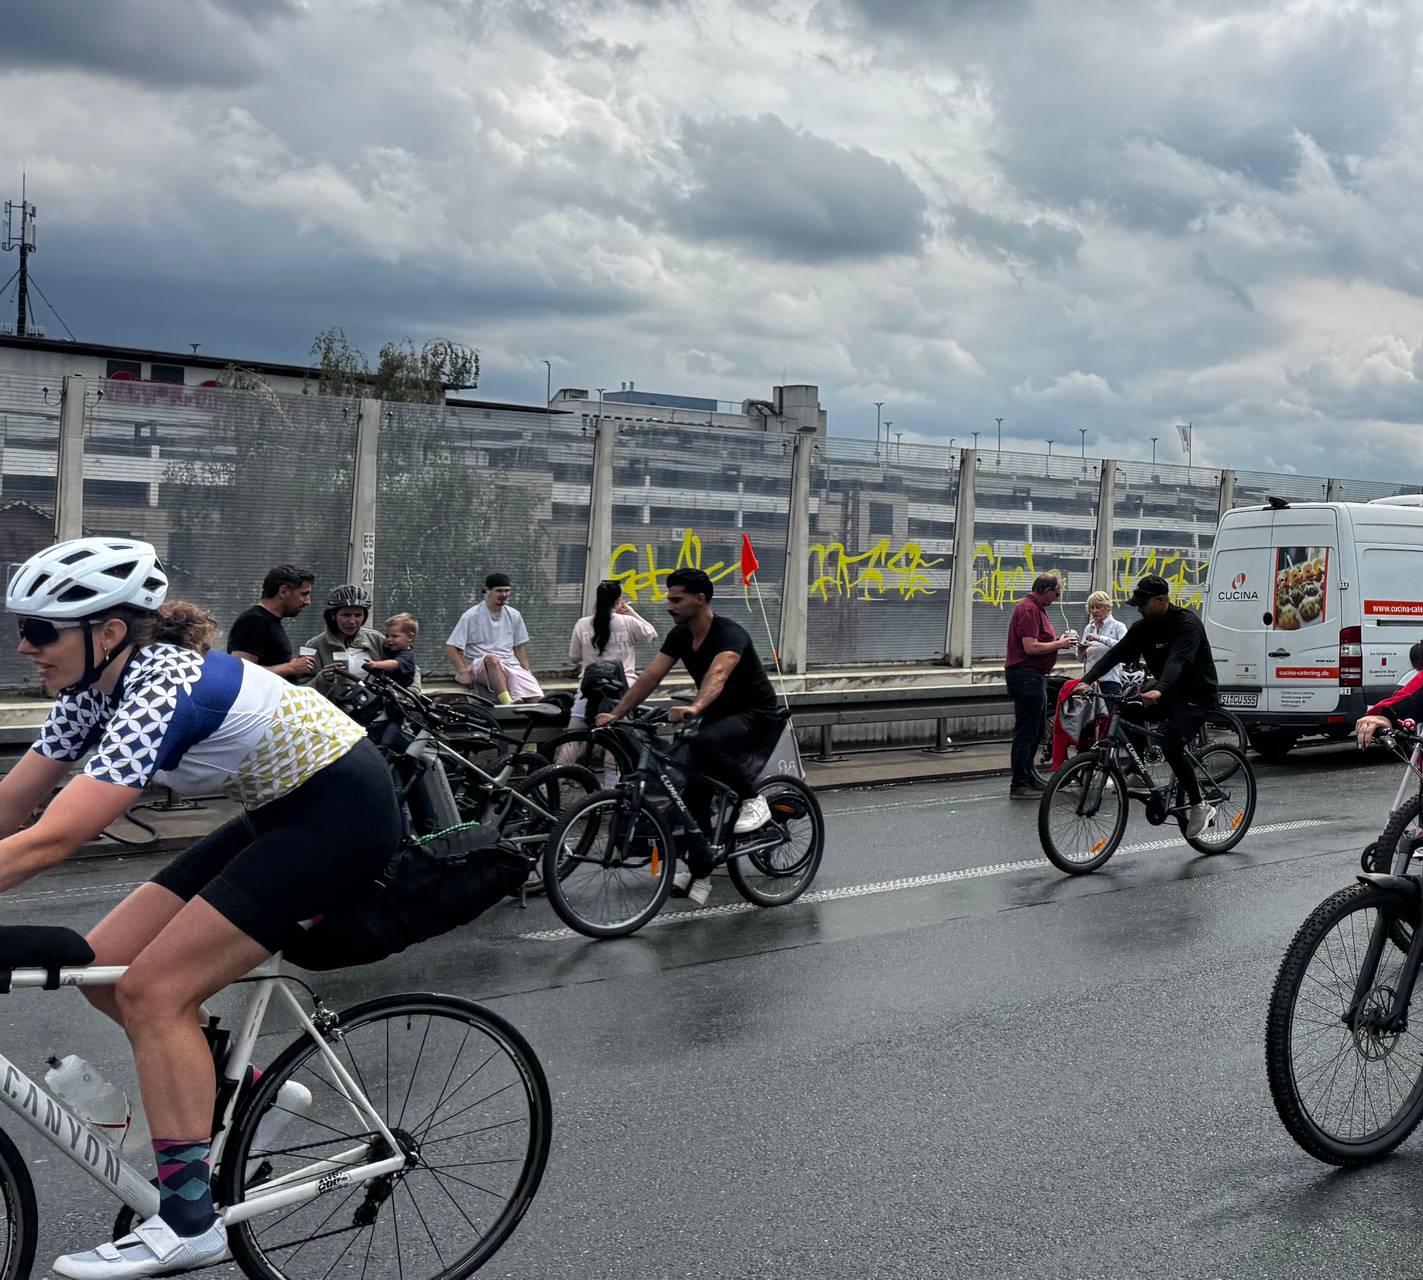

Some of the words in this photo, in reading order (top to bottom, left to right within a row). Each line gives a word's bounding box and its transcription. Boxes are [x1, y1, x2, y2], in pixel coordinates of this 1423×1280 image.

[362, 568, 374, 582] 20
[1218, 591, 1259, 601] CUCINA
[1279, 670, 1330, 678] cucina-catering.de
[4, 1064, 121, 1186] CANYON
